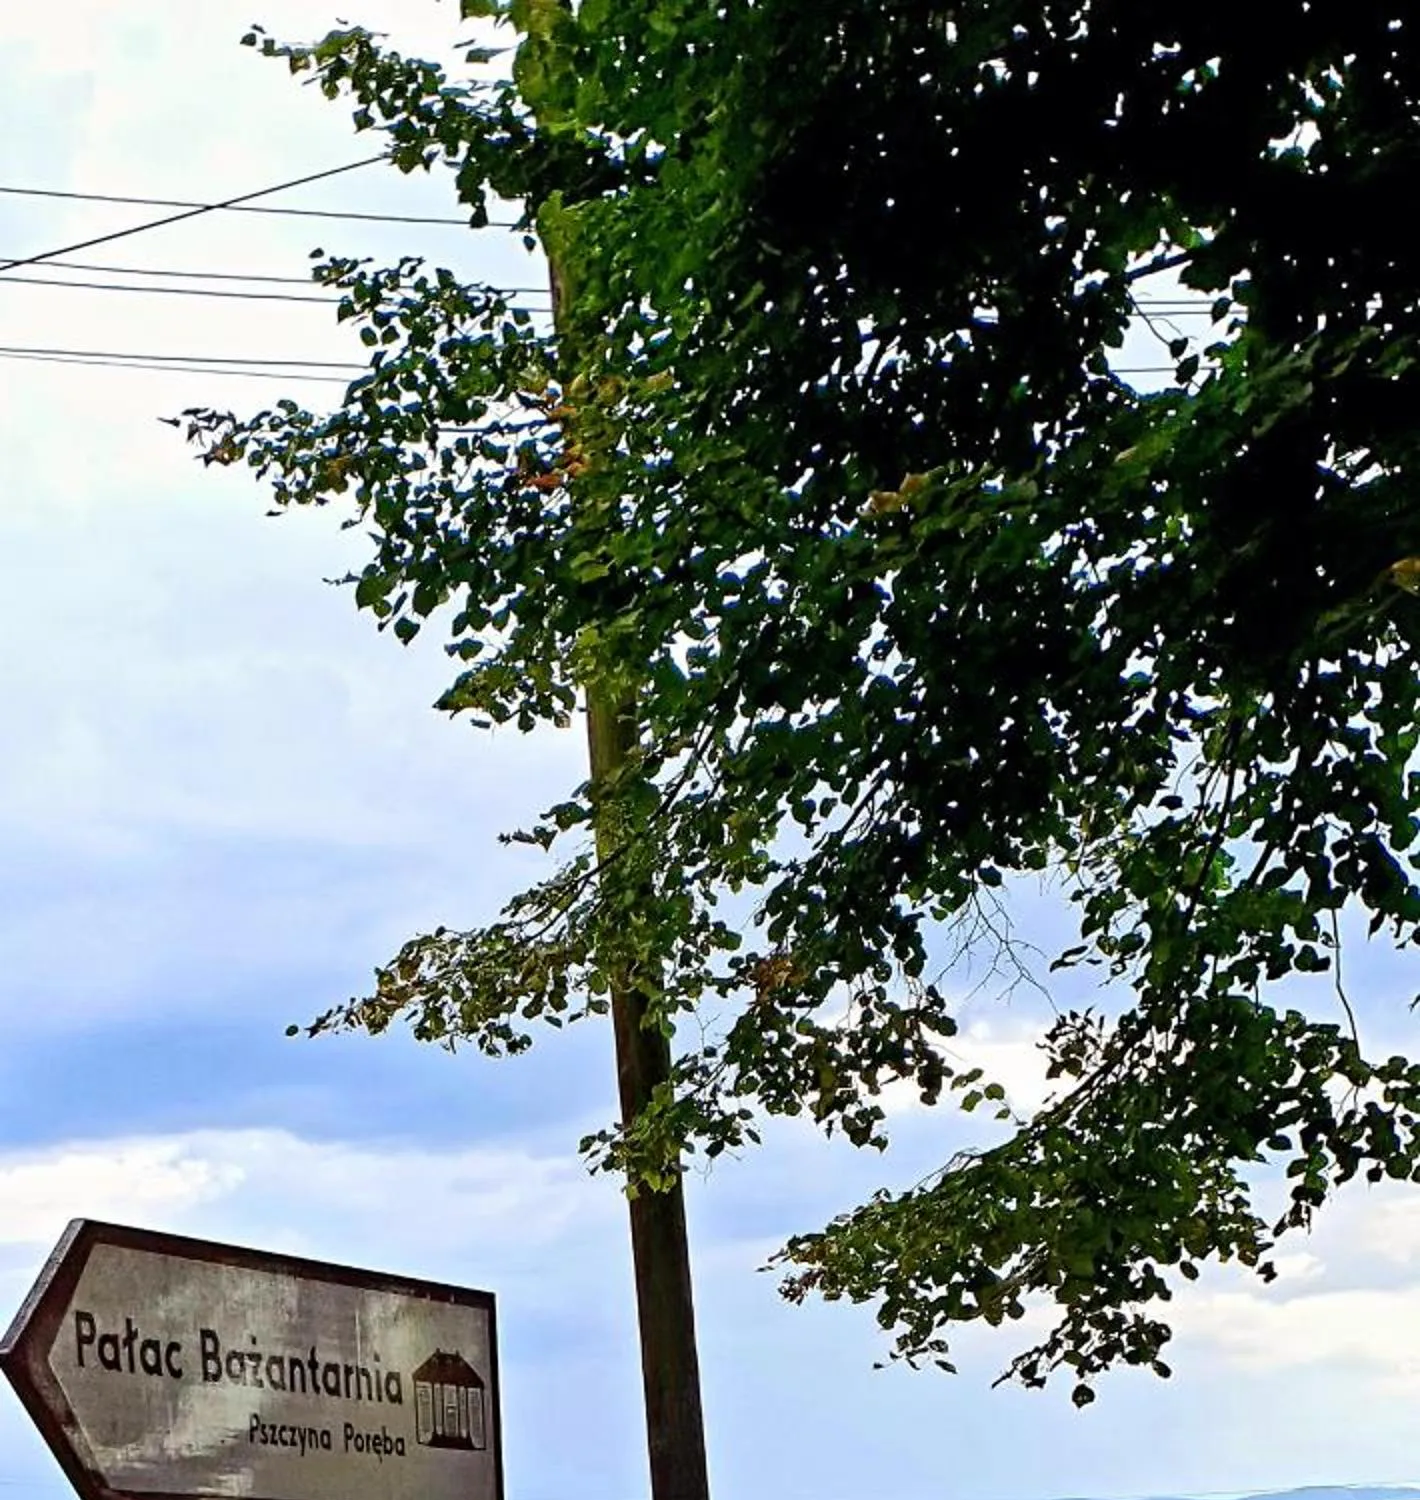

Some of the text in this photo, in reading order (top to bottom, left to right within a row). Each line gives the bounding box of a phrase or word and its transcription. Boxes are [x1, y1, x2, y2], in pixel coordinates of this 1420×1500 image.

[75, 1310, 404, 1405] Pałac Bażantarnia
[248, 1414, 407, 1459] Pszczyna Poręba
